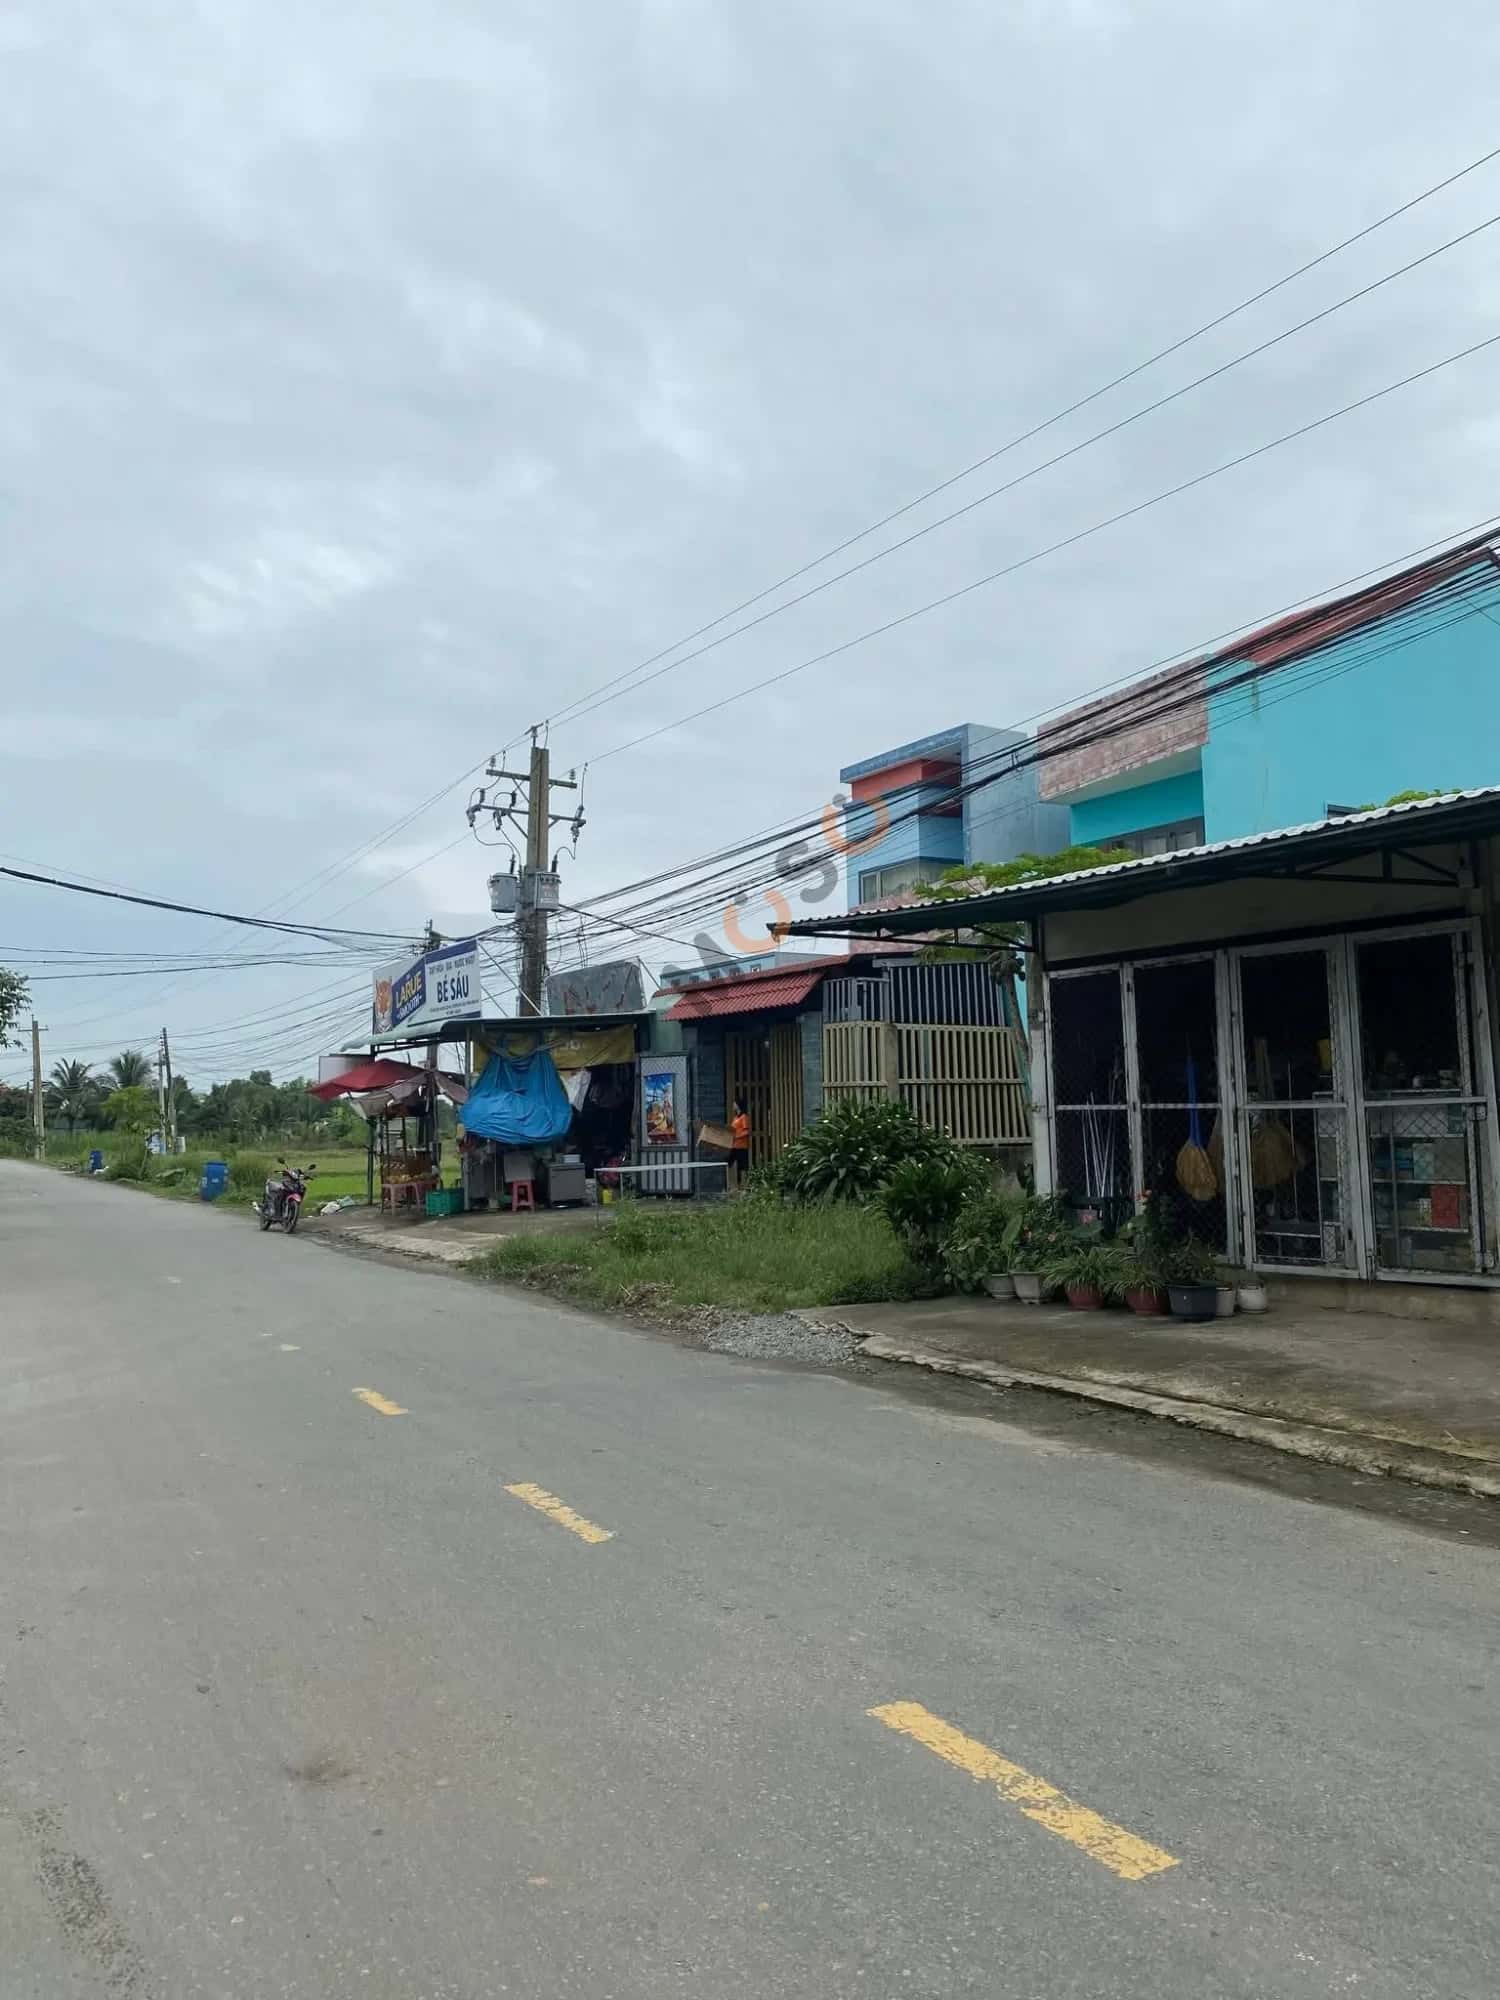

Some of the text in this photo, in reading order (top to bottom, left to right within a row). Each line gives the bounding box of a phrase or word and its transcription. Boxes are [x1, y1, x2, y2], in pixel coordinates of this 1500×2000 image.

[396, 971, 422, 1008] LARUE
[437, 970, 469, 1003] BÉ SÁU
